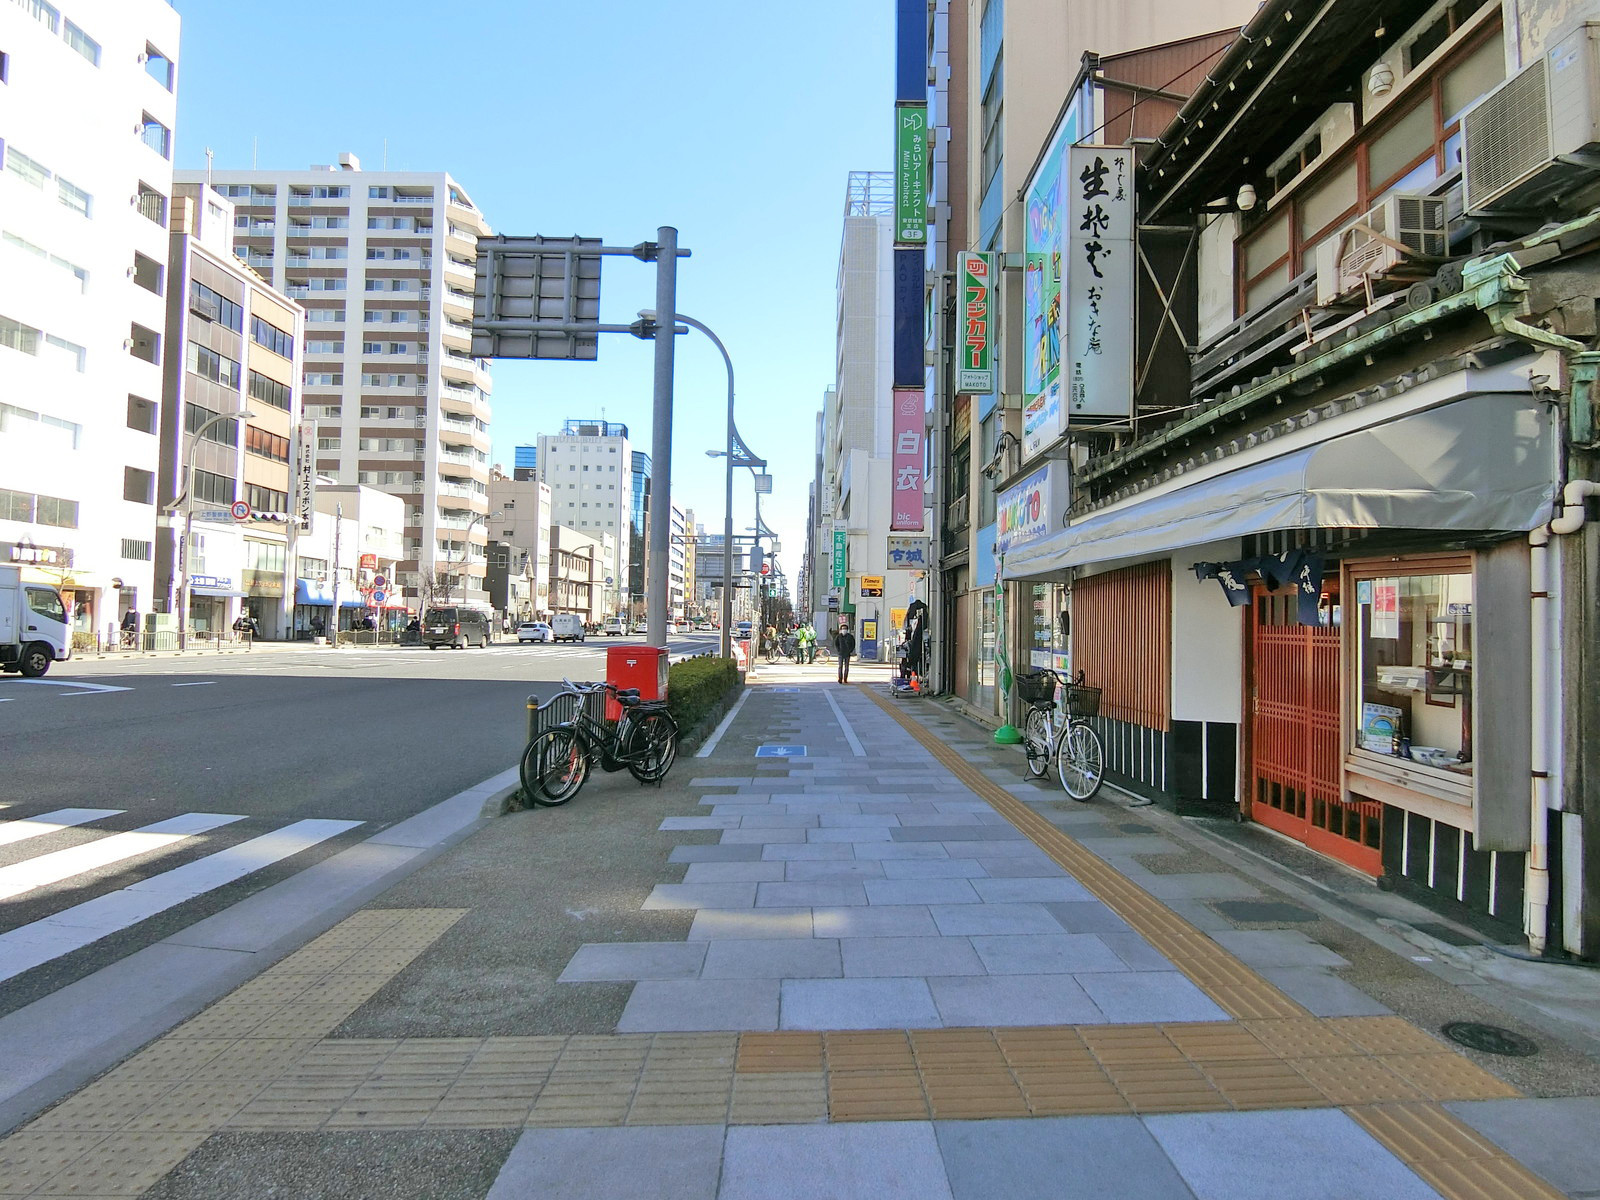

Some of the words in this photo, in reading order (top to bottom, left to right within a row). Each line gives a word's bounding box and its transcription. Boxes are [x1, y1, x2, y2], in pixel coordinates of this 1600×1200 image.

[912, 134, 922, 217] みらいアーキテクト
[966, 286, 987, 369] フジカラー
[896, 429, 921, 491] 白衣
[897, 512, 911, 521] bic
[835, 534, 843, 585] 不動産センター
[889, 548, 925, 564] 古城
